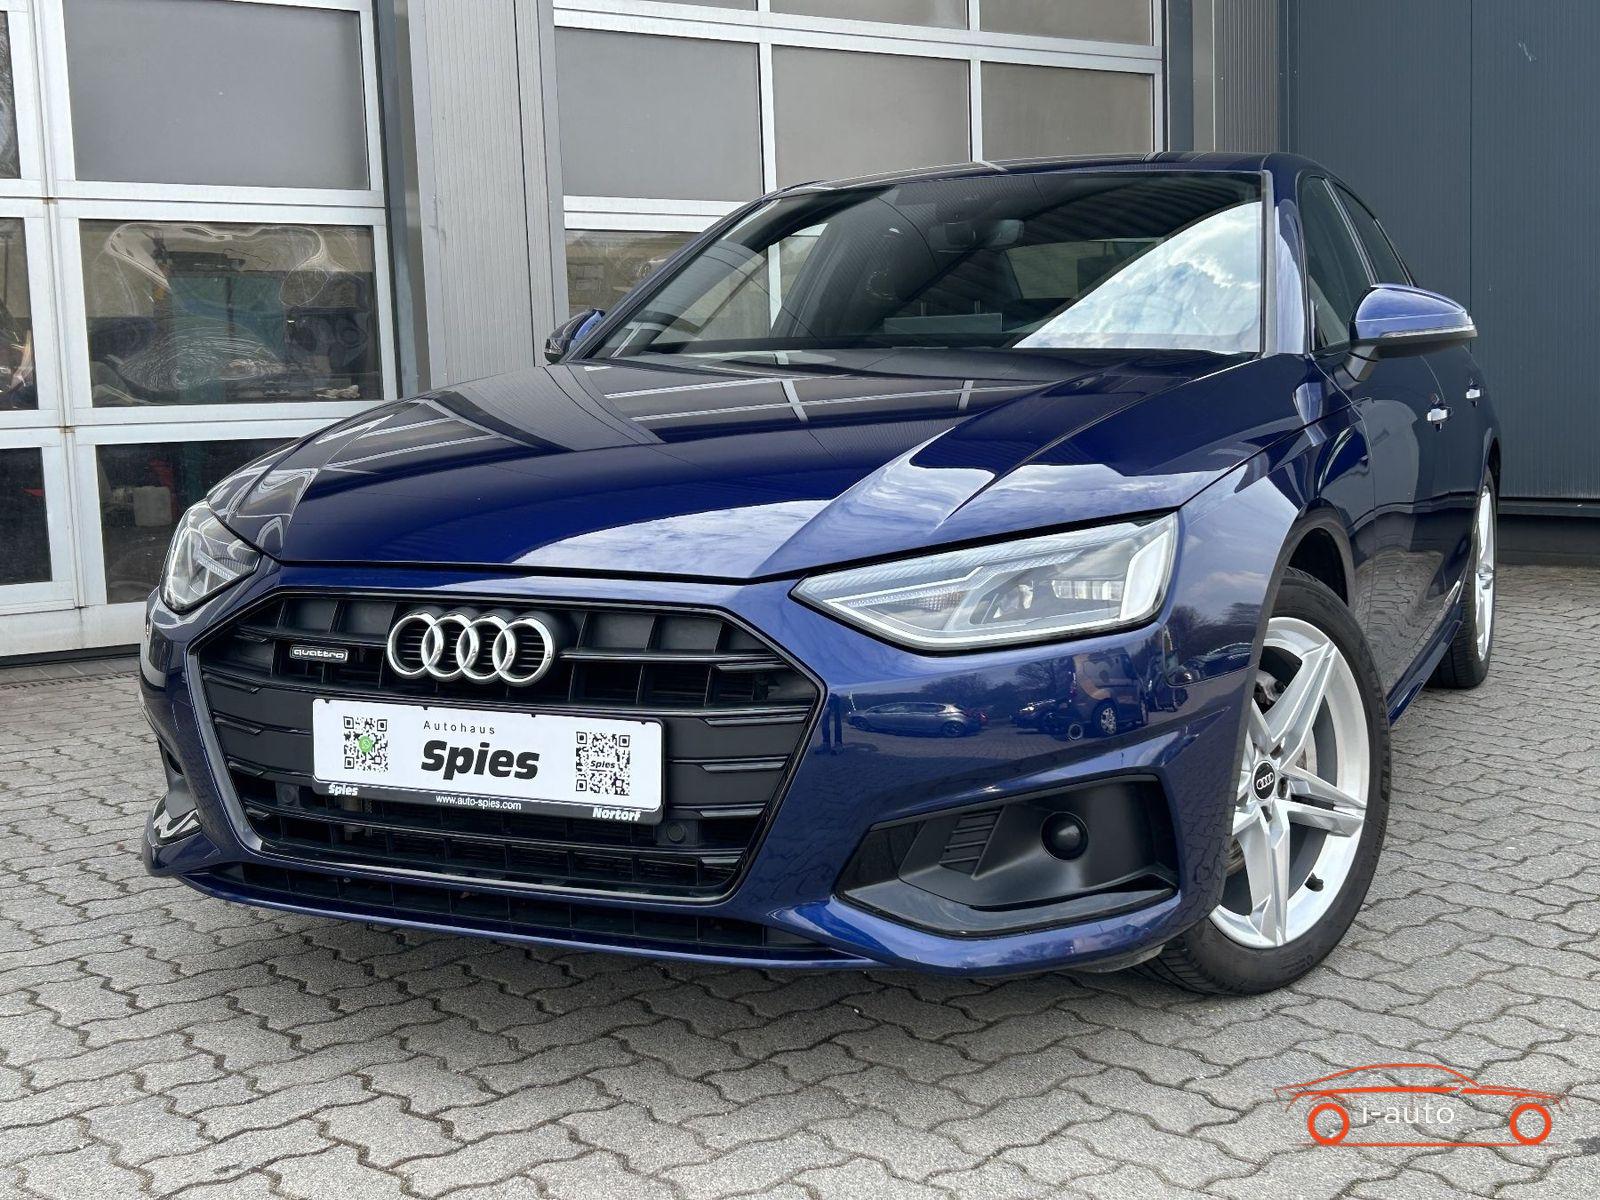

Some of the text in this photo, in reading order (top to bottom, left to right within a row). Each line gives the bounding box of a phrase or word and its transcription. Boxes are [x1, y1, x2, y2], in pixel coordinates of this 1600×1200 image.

[293, 649, 345, 660] quattro
[423, 720, 496, 735] Autohaus
[421, 740, 540, 781] Spies
[590, 760, 616, 769] Spies
[328, 783, 359, 796] Spies
[435, 795, 522, 810] www.auto-spies.com
[592, 807, 642, 821] Nortorf
